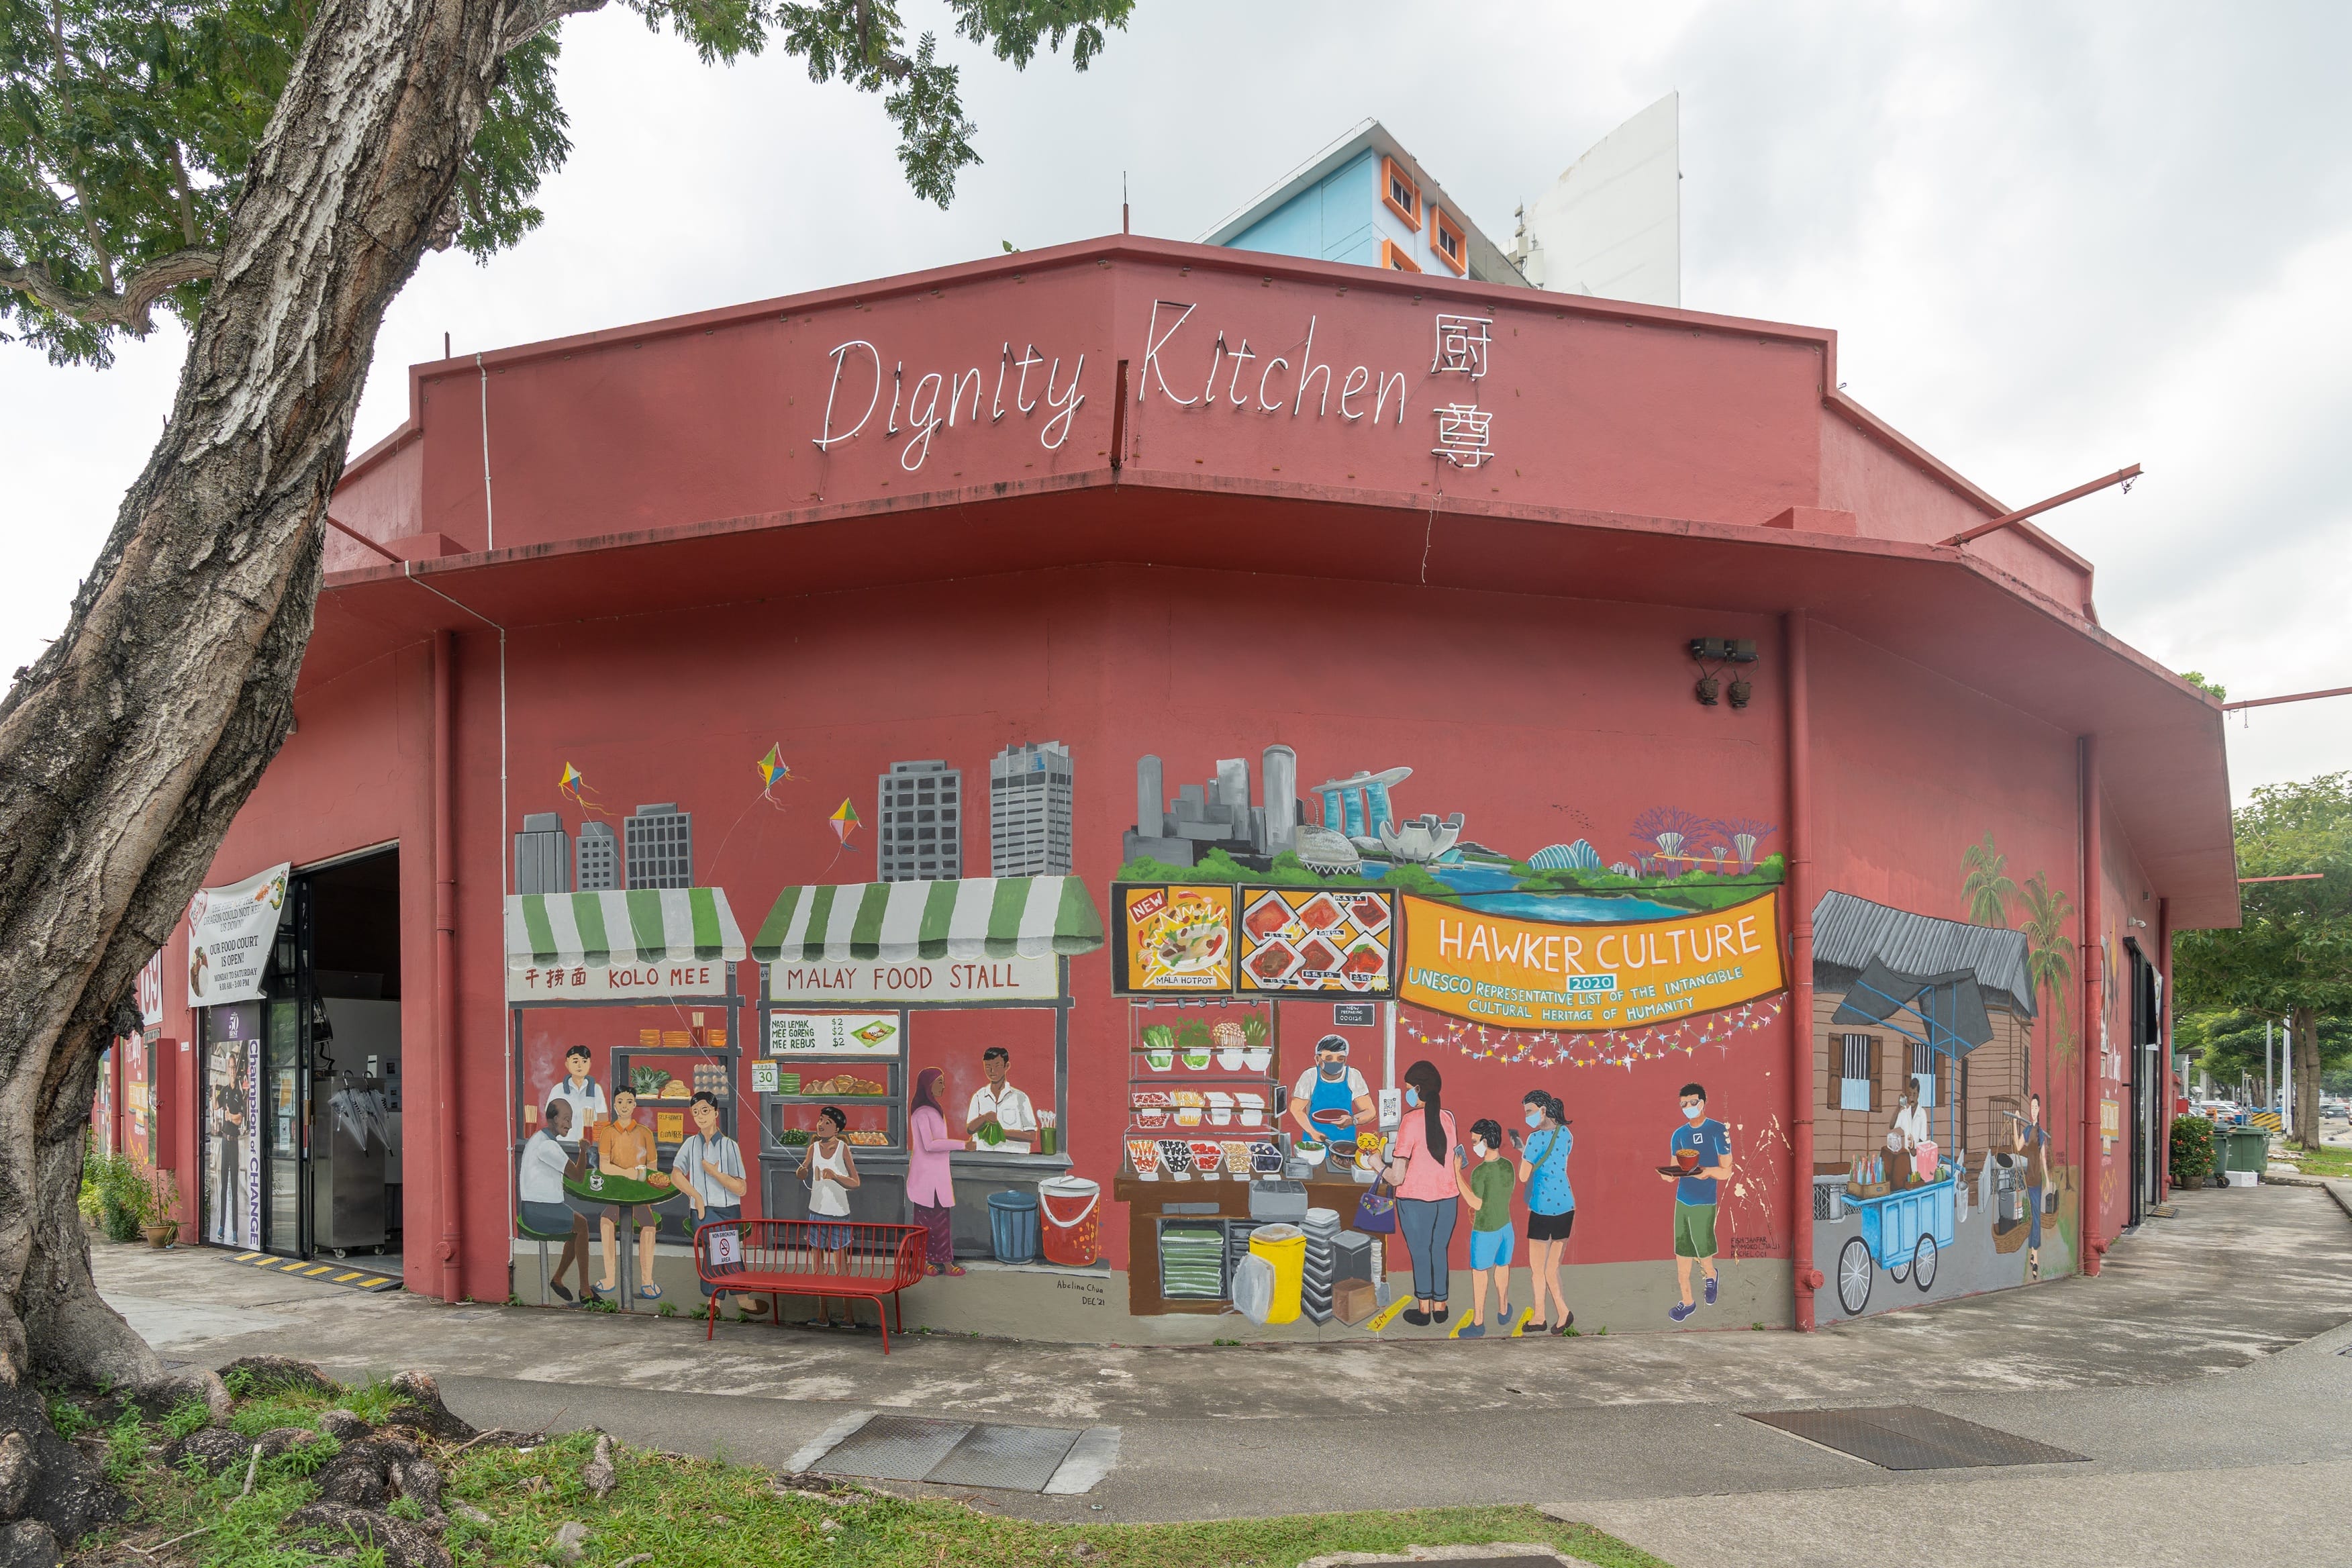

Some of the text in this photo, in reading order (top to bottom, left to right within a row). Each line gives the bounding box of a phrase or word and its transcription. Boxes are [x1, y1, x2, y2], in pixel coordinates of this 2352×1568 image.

[812, 299, 1407, 471] Dignity Kitchen
[1132, 892, 1163, 918] NEW
[203, 913, 222, 926] DRAGON
[222, 909, 238, 921] COULD
[239, 906, 251, 918] NOT
[220, 922, 228, 932] US
[209, 935, 258, 955] OUR FOOD COURT
[1439, 915, 1762, 974] HAWKER CULTURE
[221, 952, 244, 967] IS OPEN!
[214, 967, 258, 982] MONDAY TO SATURDAY
[727, 963, 736, 973] 63
[760, 969, 769, 979] 64
[525, 967, 587, 989] 干捞面
[608, 967, 710, 989] KOLO MEE
[787, 963, 1020, 989] MALAY FOOD STALL
[1156, 977, 1214, 985] MALA HOTPOT
[1572, 977, 1612, 990] 2020
[226, 981, 232, 989] AM
[242, 979, 250, 987] PM
[1408, 967, 1745, 1006] UNESCO REPRESENTATIVE LIST OF THE INTANGIBLE
[1468, 996, 1696, 1022] CULTURAL HERITAGE OF HUMANITY
[229, 1016, 239, 1030] 50
[772, 1020, 787, 1029] NASI
[788, 1019, 810, 1028] LEMAK
[772, 1026, 844, 1038] MEE GORENG $2
[772, 1038, 845, 1049] MEE REBUS $2
[758, 1071, 773, 1083] 30
[249, 1040, 259, 1246] Champion of CHANGE
[712, 1230, 736, 1238] NON-SMOKING
[1087, 1283, 1104, 1293] Chua
[1374, 1313, 1387, 1329] 1M
